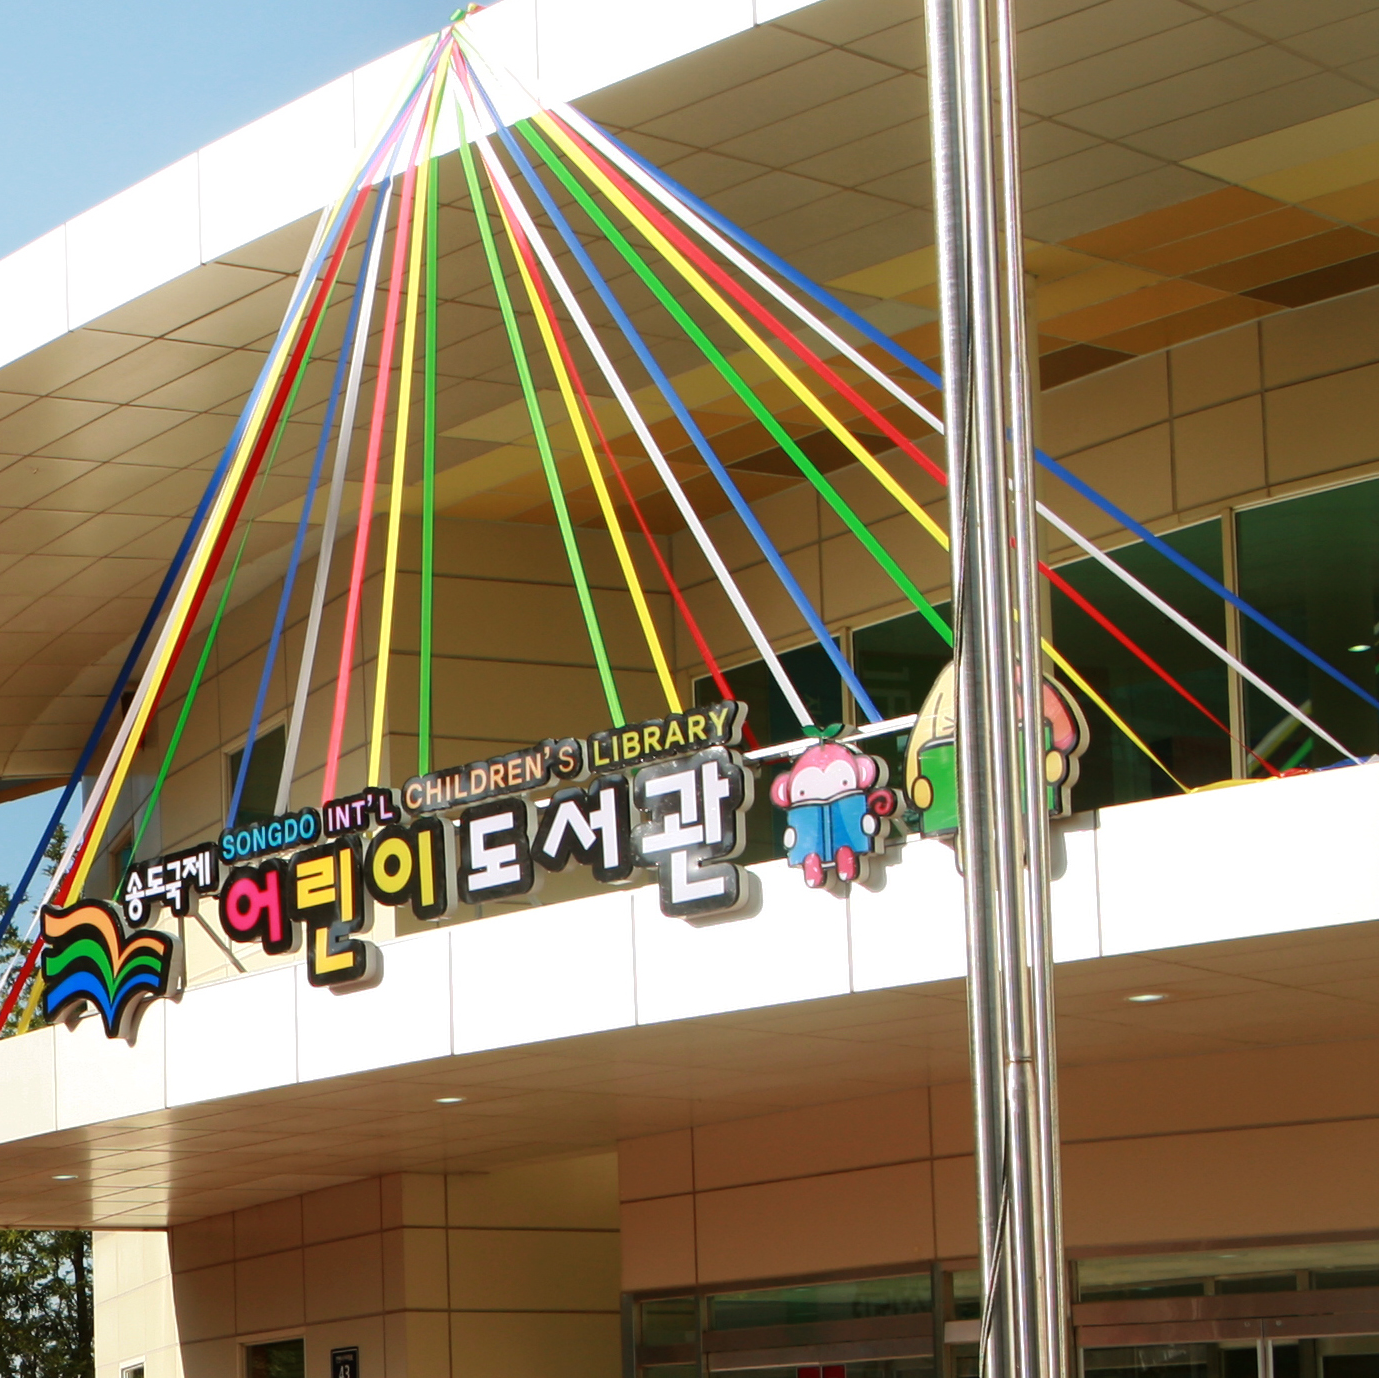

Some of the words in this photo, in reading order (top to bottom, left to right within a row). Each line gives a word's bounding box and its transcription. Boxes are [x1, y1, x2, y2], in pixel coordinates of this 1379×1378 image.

[222, 813, 316, 860] SONGDO
[327, 791, 393, 832] INT'L
[405, 745, 578, 810] CHILDREN'S
[593, 707, 730, 767] LIBRARY
[125, 851, 211, 921] 송도국제
[225, 829, 434, 975] 어린이
[467, 760, 730, 904] 도서관
